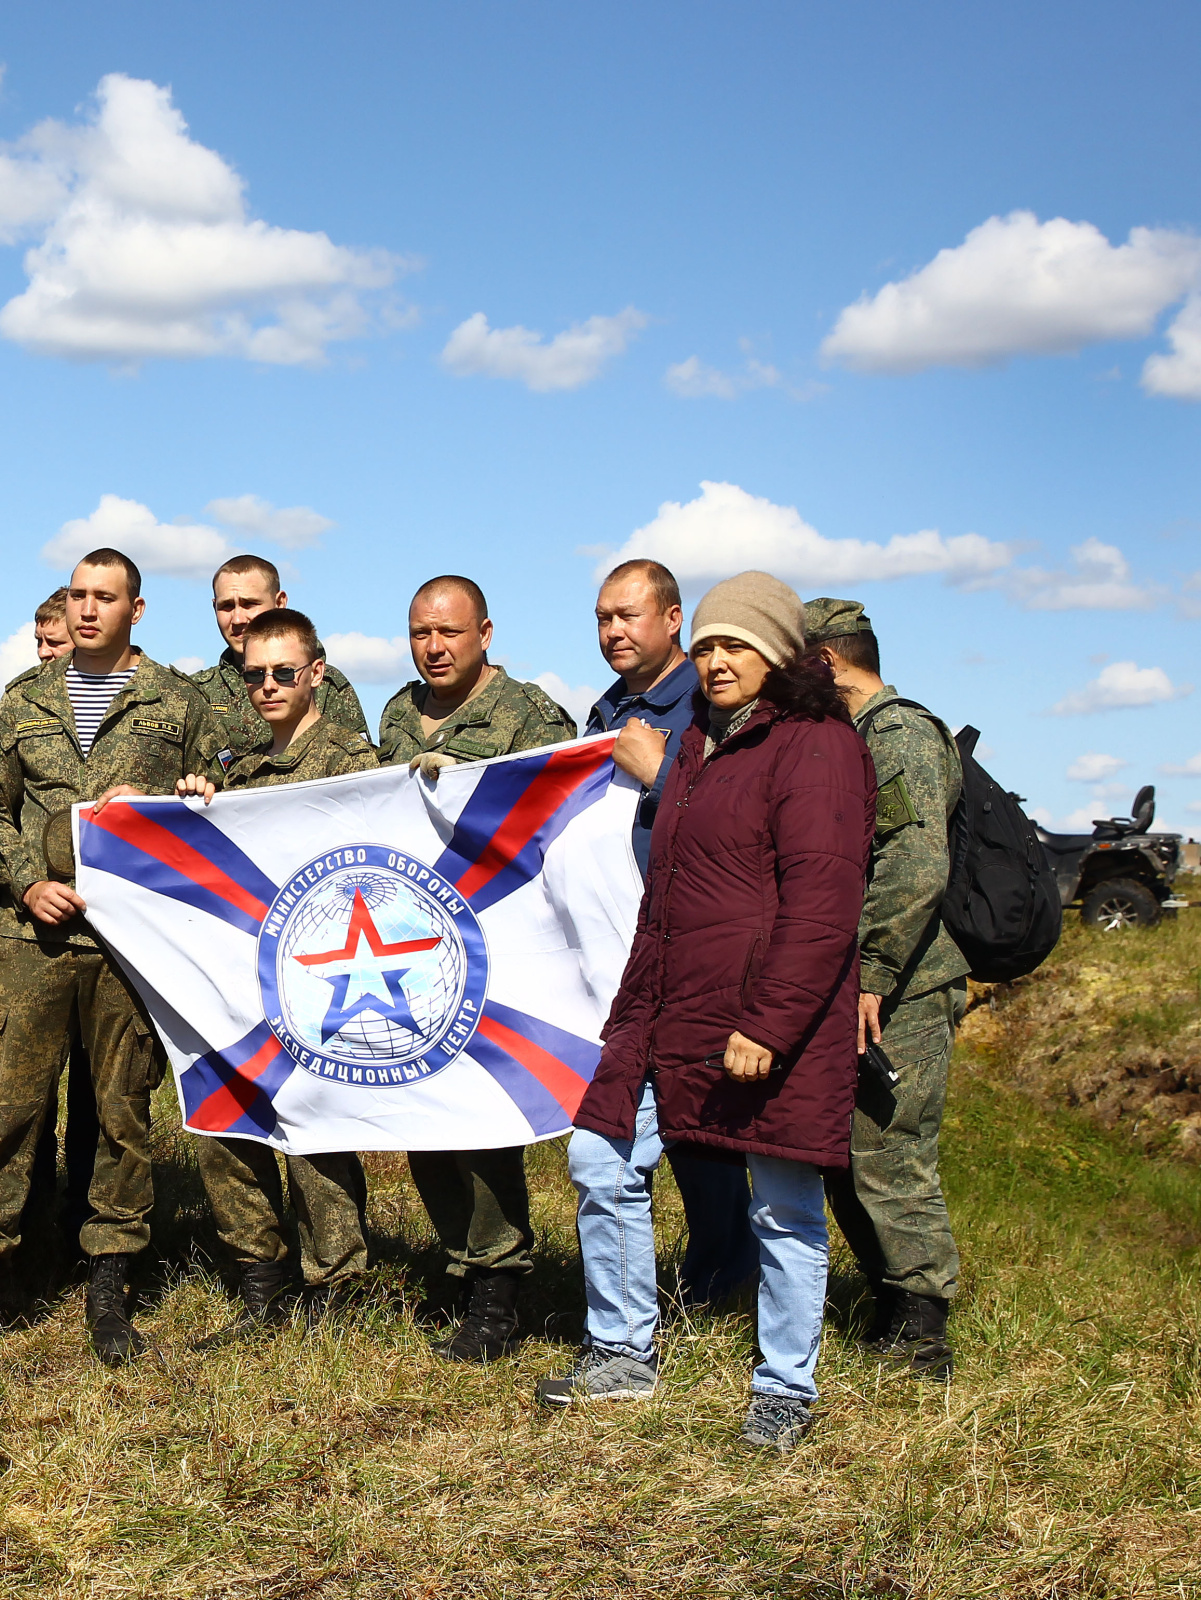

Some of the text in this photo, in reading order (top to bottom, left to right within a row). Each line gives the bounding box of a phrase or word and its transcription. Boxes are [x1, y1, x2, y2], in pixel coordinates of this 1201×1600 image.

[138, 720, 159, 728] ЛЬВОВ
[265, 848, 466, 938] МИНИСТЕРСТВО ОБОРОНЫ
[269, 998, 479, 1085] ЭКСПЕДИЦИОННЫЙ ЦЕНТР
